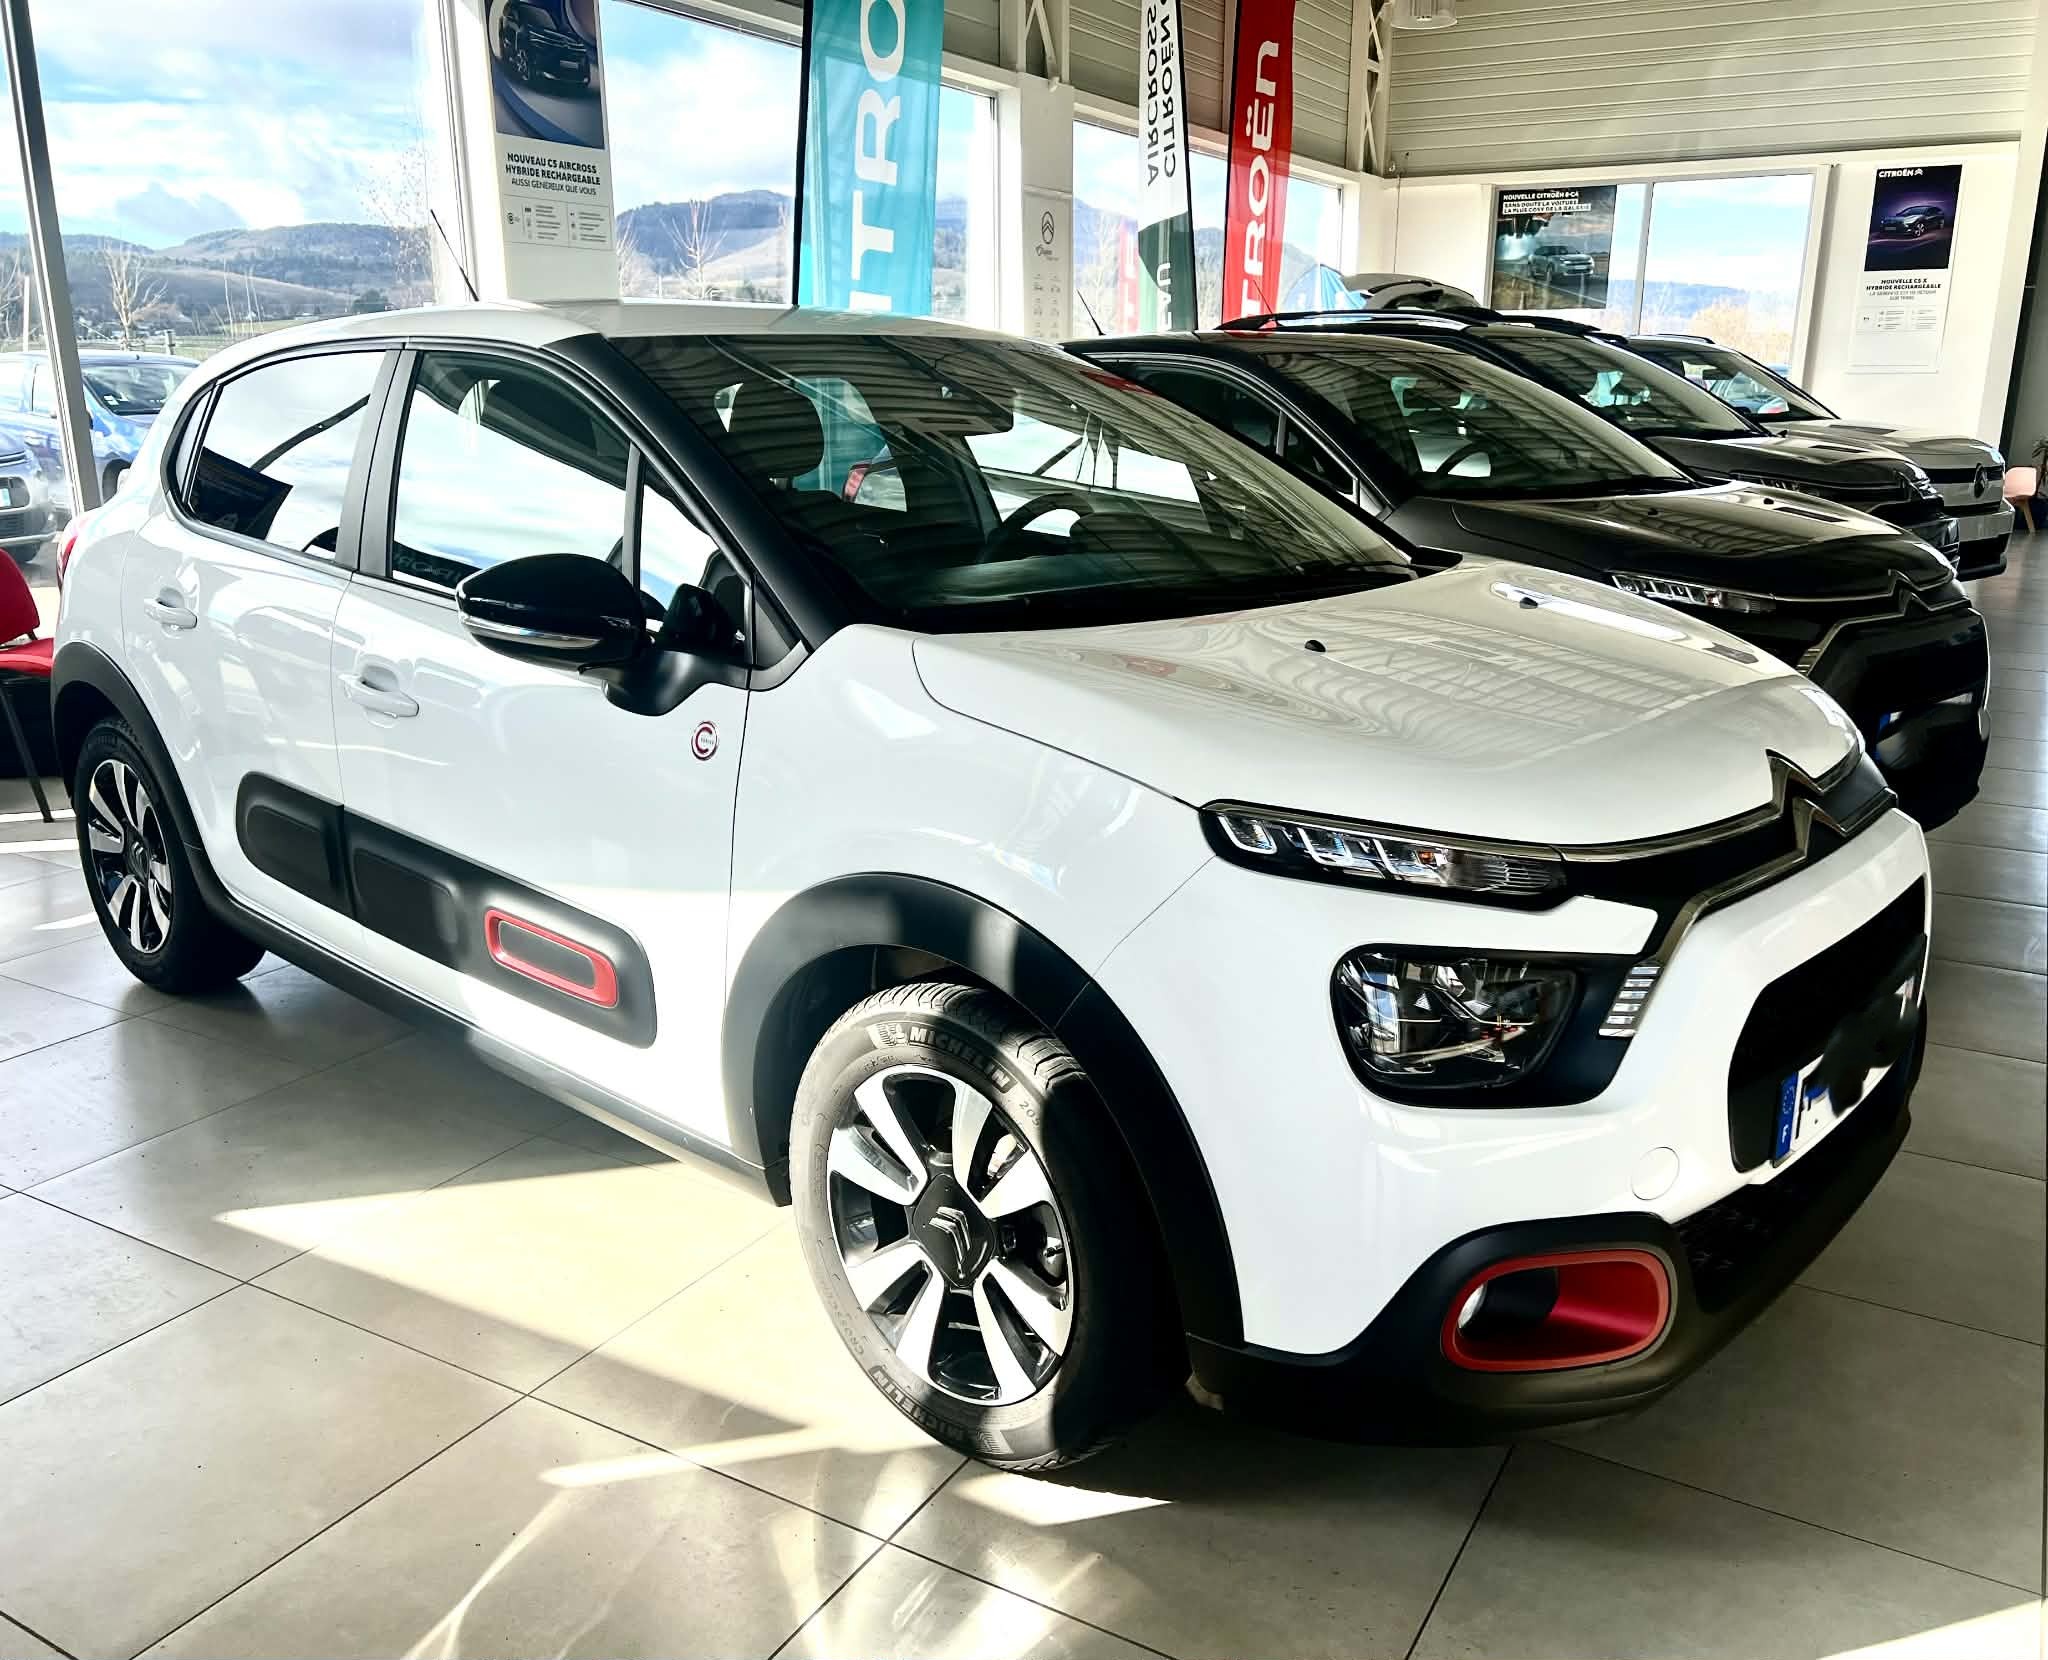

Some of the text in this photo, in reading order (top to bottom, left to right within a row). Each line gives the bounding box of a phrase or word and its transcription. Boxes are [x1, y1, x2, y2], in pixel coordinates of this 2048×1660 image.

[507, 152, 546, 167] NOUVEAU
[559, 160, 597, 174] AIRCROSS
[505, 164, 601, 186] HYBRIDE RECHARGEABLE
[511, 177, 530, 188] AUSSI
[565, 185, 578, 194] QUE
[579, 186, 597, 196] VOUS
[909, 1025, 1011, 1088] MICHELIN
